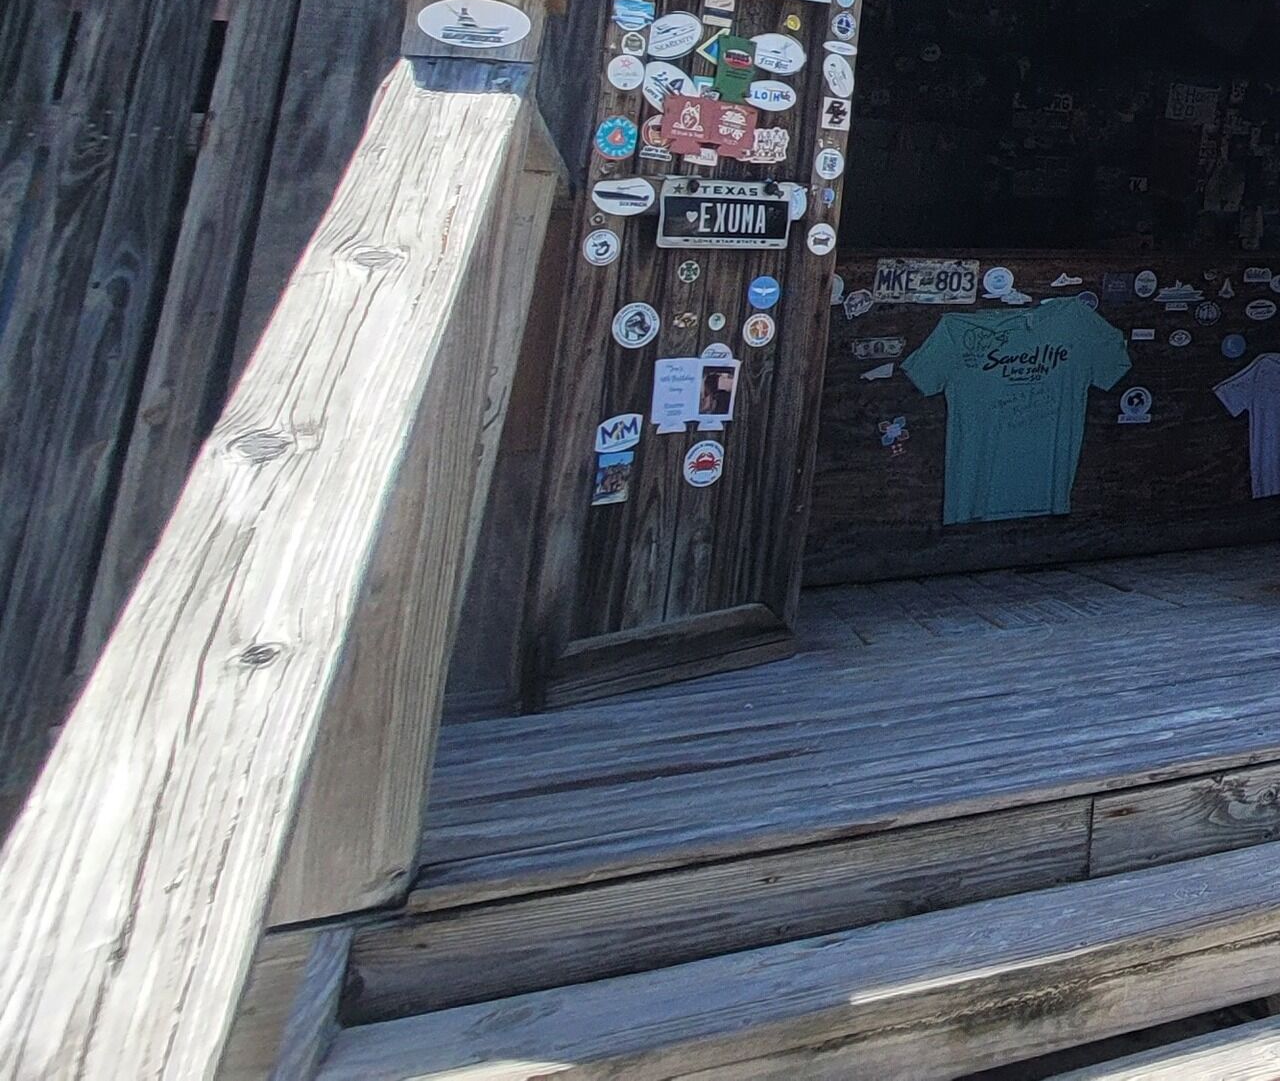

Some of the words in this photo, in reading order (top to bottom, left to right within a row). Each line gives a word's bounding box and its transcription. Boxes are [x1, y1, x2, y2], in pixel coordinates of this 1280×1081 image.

[700, 185, 758, 197] TEXAS
[698, 202, 766, 234] EXUMA
[877, 270, 917, 292] MKE
[935, 270, 975, 293] 803
[982, 346, 1040, 371] Saved
